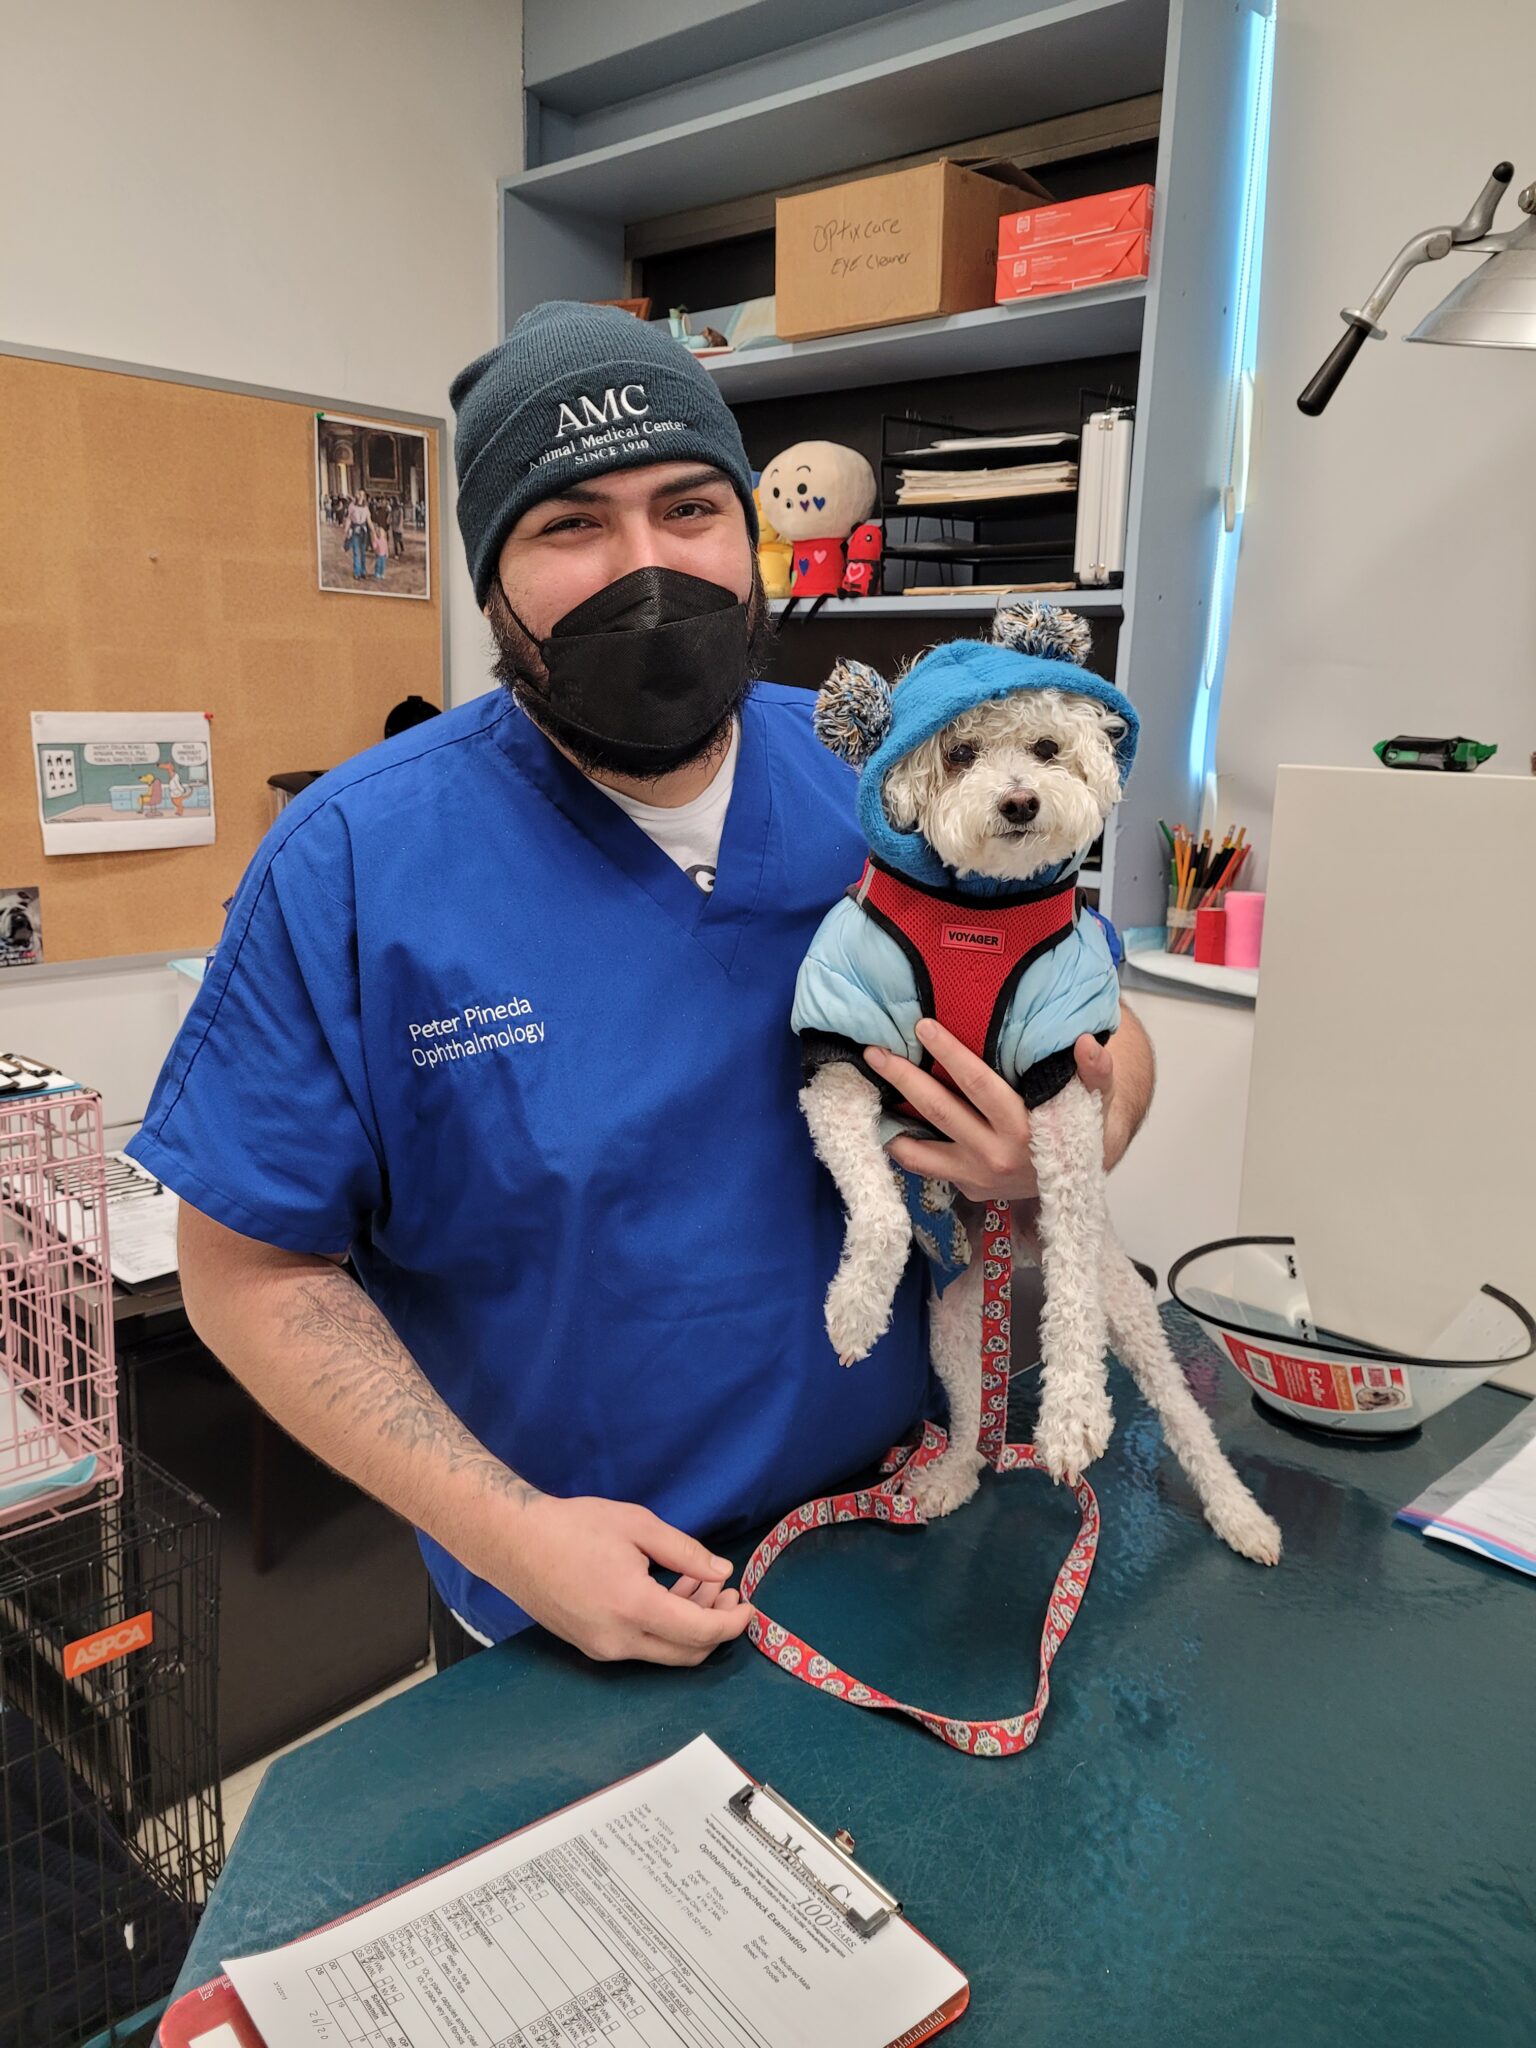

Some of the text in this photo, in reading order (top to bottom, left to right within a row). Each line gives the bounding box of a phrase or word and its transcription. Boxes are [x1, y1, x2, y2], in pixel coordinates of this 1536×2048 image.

[554, 383, 650, 438] AMC
[580, 421, 640, 450] Medical
[642, 418, 688, 435] Center
[574, 438, 650, 466] SINCE 1910
[947, 930, 1000, 947] VOYAGER
[408, 996, 534, 1043] Peter Pineda
[411, 1020, 546, 1070] Ophthalmology
[72, 1623, 147, 1671] ASPCA
[696, 1842, 745, 1888] Ophthalmology
[738, 1885, 771, 1914] Recheck
[764, 1911, 811, 1954] Examination
[794, 1894, 836, 1928] 100
[827, 1922, 859, 1948] YEARS
[636, 1918, 656, 1935] surgery
[650, 1933, 670, 1951] several
[664, 1948, 684, 1967] months
[679, 1965, 693, 1977] ago
[315, 1966, 325, 1976] OS
[327, 1960, 338, 1971] OD
[761, 1965, 782, 1983] Poodle
[768, 1960, 790, 1979] Canine
[776, 1955, 813, 1990] Neutered Male
[449, 1974, 458, 1983] no
[454, 1966, 464, 1975] no
[459, 1972, 472, 1986] flare
[669, 1969, 694, 1995] doing great
[453, 1980, 467, 1994] flare
[350, 1995, 358, 2003] 17
[370, 1993, 389, 2017] Schirmer
[427, 1975, 436, 1983] in
[439, 1995, 459, 2019] capsules
[454, 2016, 471, 2035] almost
[615, 1996, 630, 2011] WNL
[622, 1992, 637, 2006] WNL
[568, 2000, 598, 2033] Conjunctiva
[589, 2011, 605, 2026] WNL
[597, 2007, 613, 2022] WNL
[681, 2006, 693, 2016] OU
[433, 2004, 445, 2016] very
[441, 2014, 453, 2027] mild
[449, 2025, 467, 2045] fibrosis
[566, 2026, 581, 2041] WNL
[574, 2021, 590, 2037] WNL
[373, 2032, 381, 2040] 12
[398, 2035, 409, 2048] IOP
